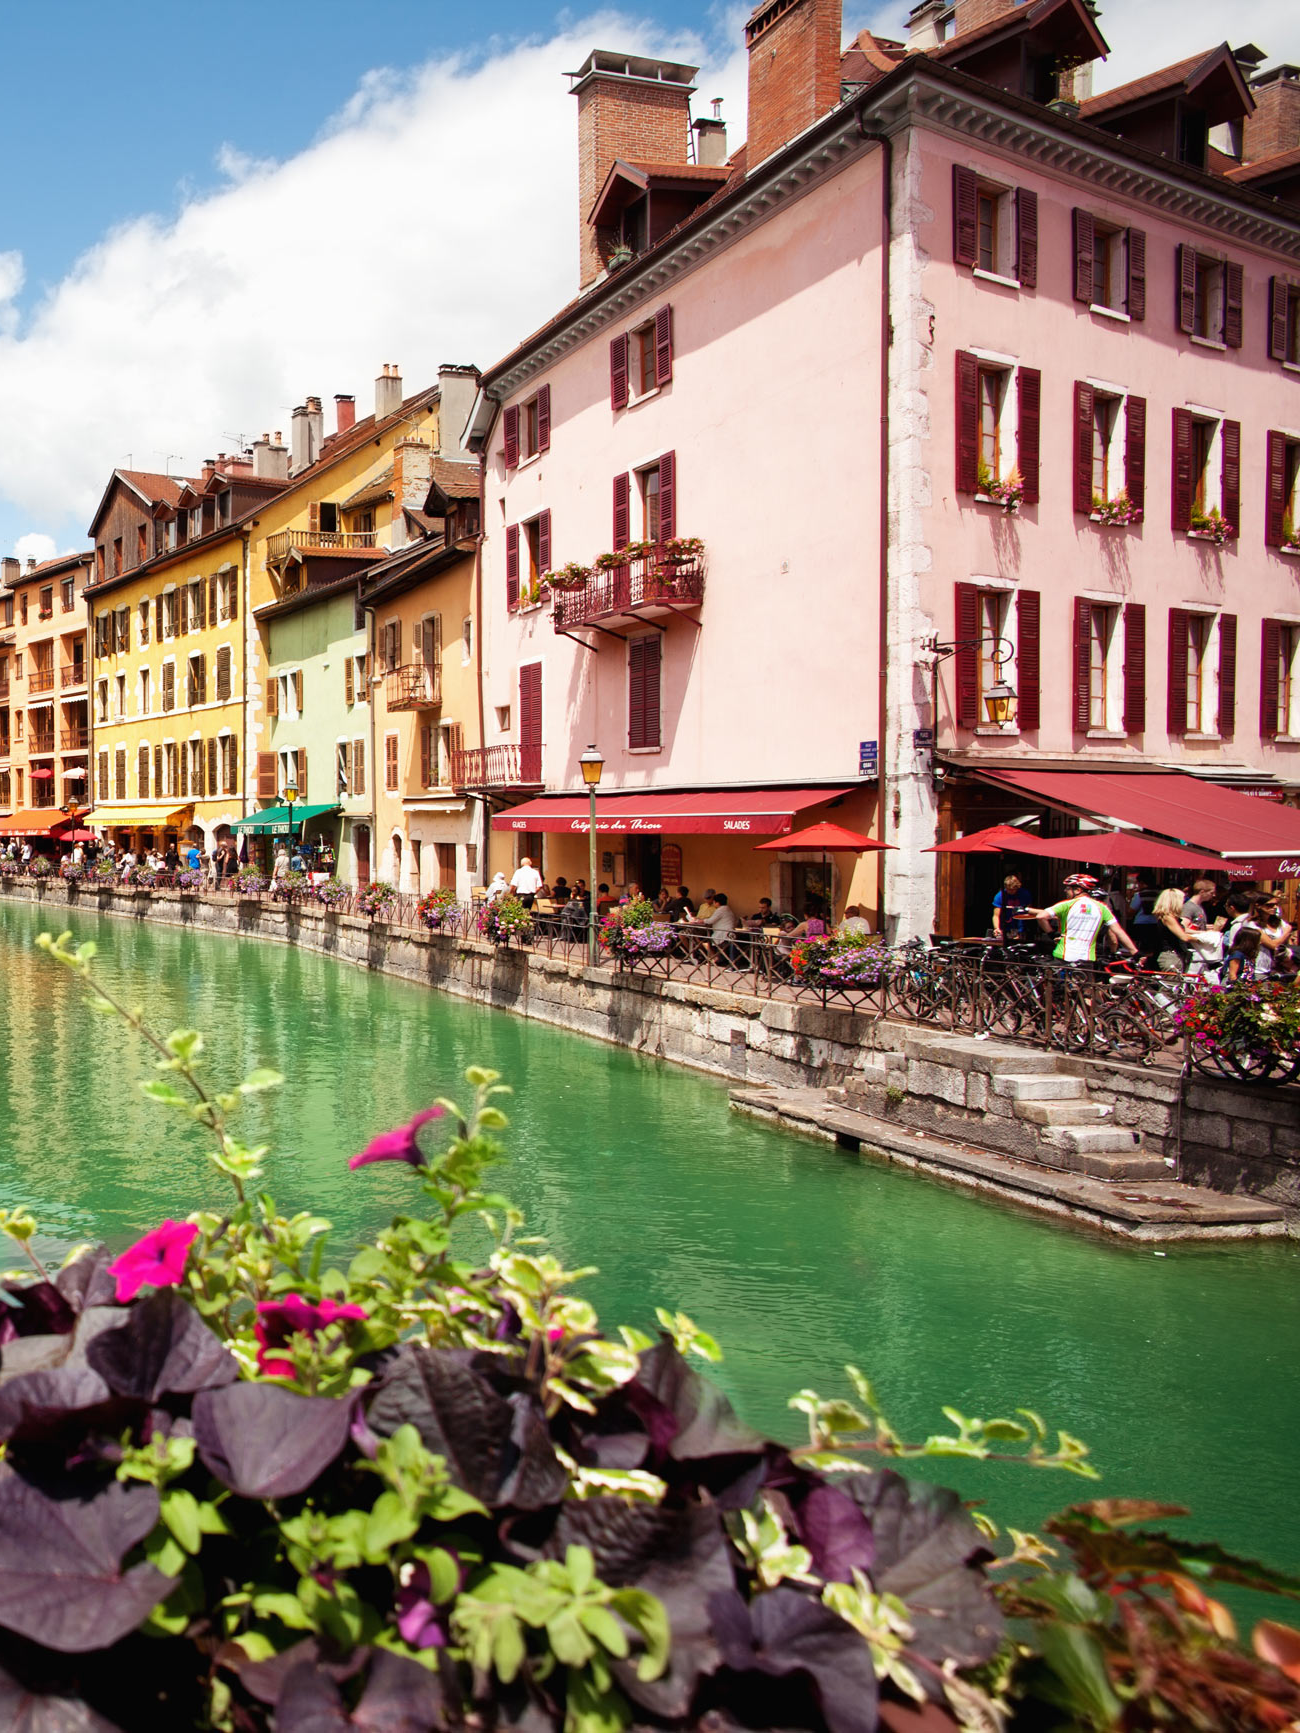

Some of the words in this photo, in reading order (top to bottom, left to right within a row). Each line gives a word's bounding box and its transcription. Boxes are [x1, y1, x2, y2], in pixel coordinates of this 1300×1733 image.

[571, 819, 610, 833] Crêprie
[610, 819, 626, 830] du
[630, 818, 662, 830] Thiou
[723, 820, 751, 830] SALADES
